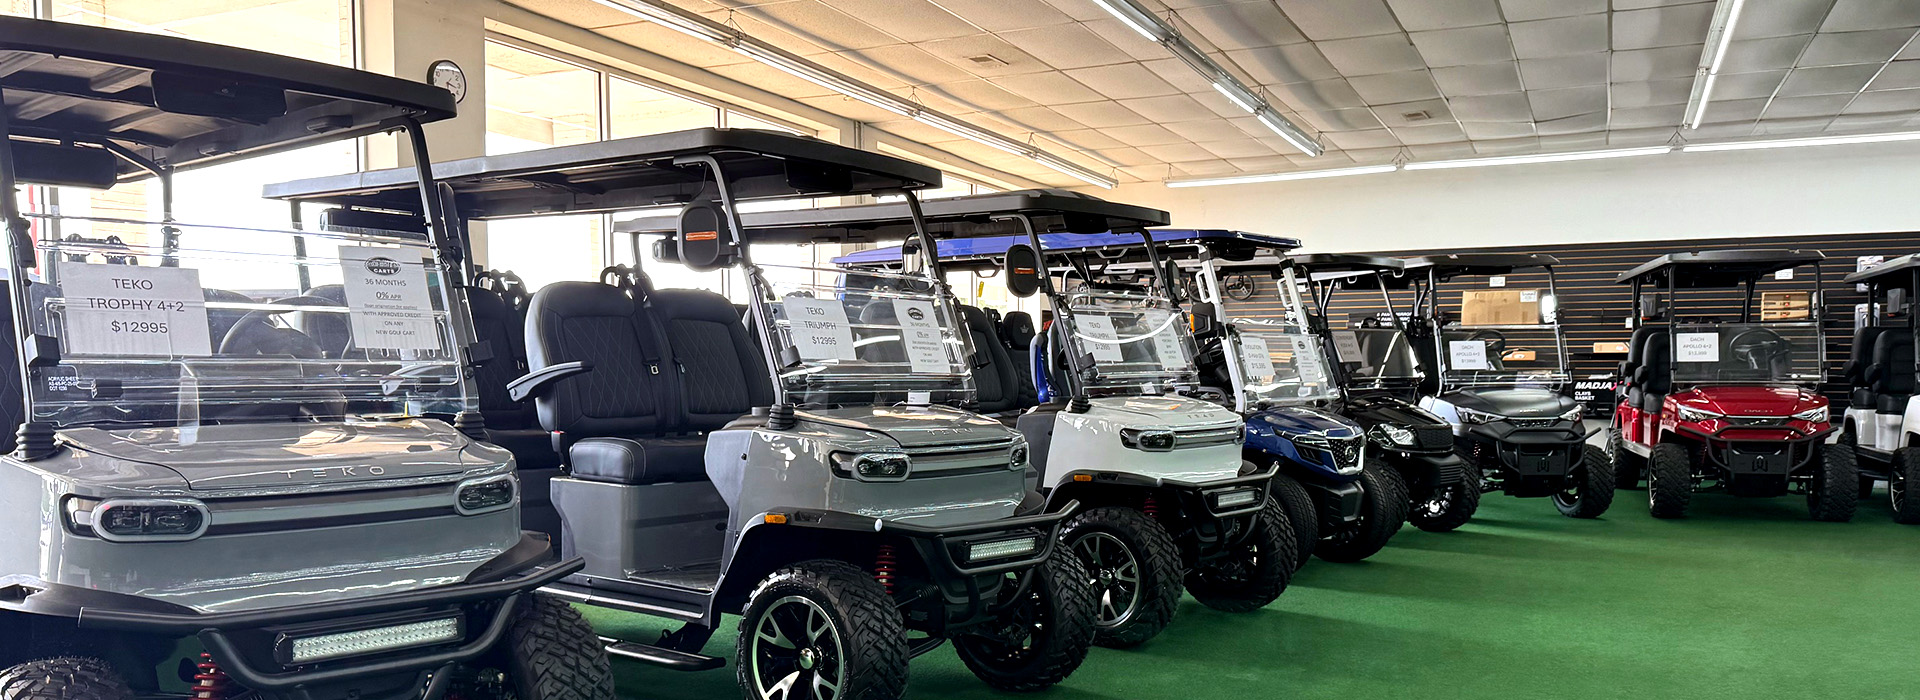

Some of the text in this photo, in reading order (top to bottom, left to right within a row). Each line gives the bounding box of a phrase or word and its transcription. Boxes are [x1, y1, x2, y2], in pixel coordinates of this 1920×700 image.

[112, 278, 153, 290] TEKO
[376, 291, 389, 299] 0%
[87, 297, 185, 312] TROPHY 4+2
[805, 306, 825, 315] TEKO
[111, 320, 168, 334] $12995
[804, 320, 837, 330] TRIUMPH
[811, 335, 837, 345] $12995
[281, 466, 384, 479] TEKO
